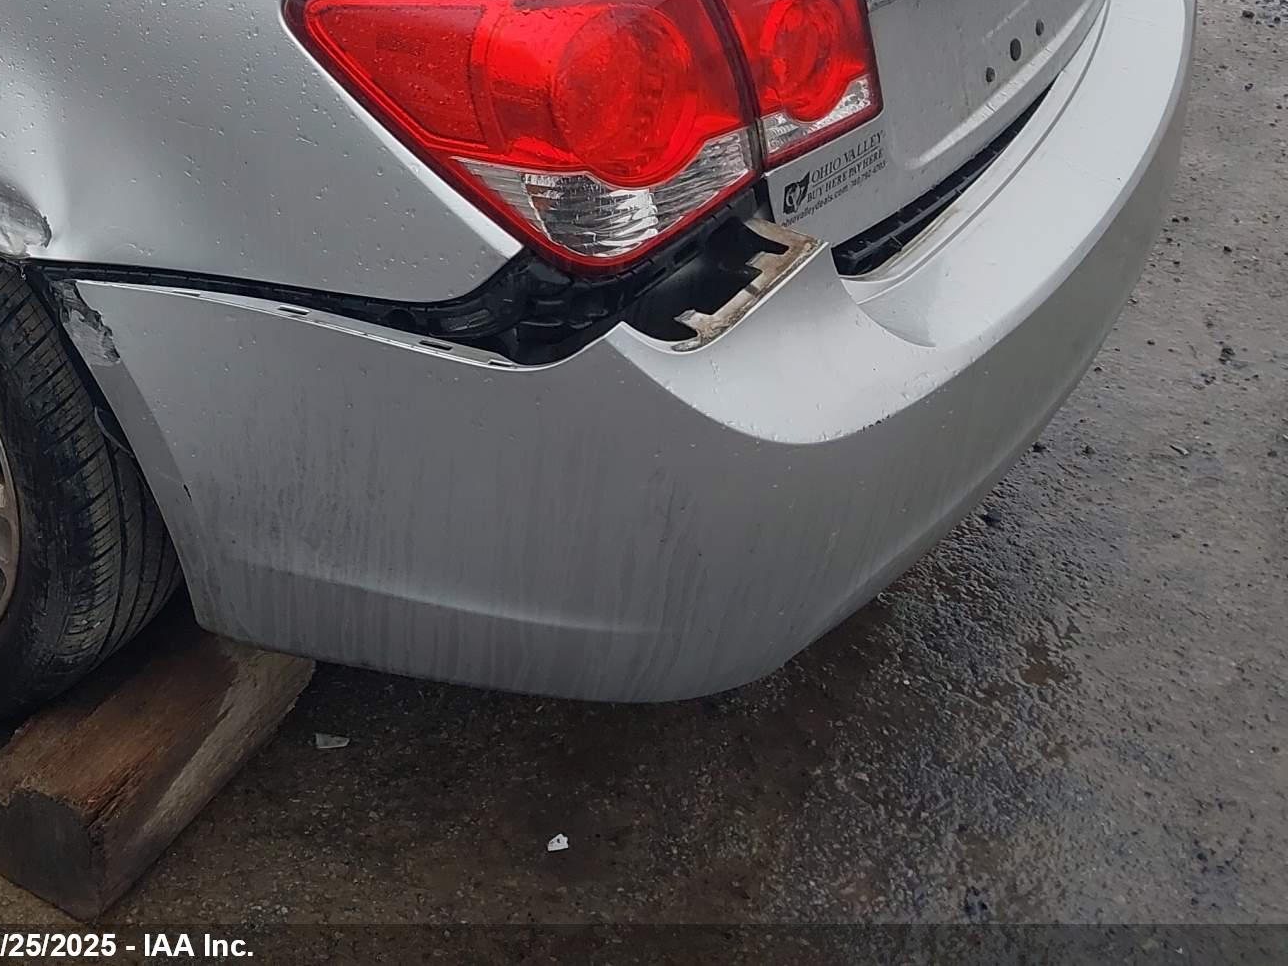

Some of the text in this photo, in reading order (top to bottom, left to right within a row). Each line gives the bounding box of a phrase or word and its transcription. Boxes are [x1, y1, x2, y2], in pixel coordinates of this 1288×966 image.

[807, 148, 884, 203] BUY HERE PAY HERE
[811, 130, 884, 183] OHIO VALLEY
